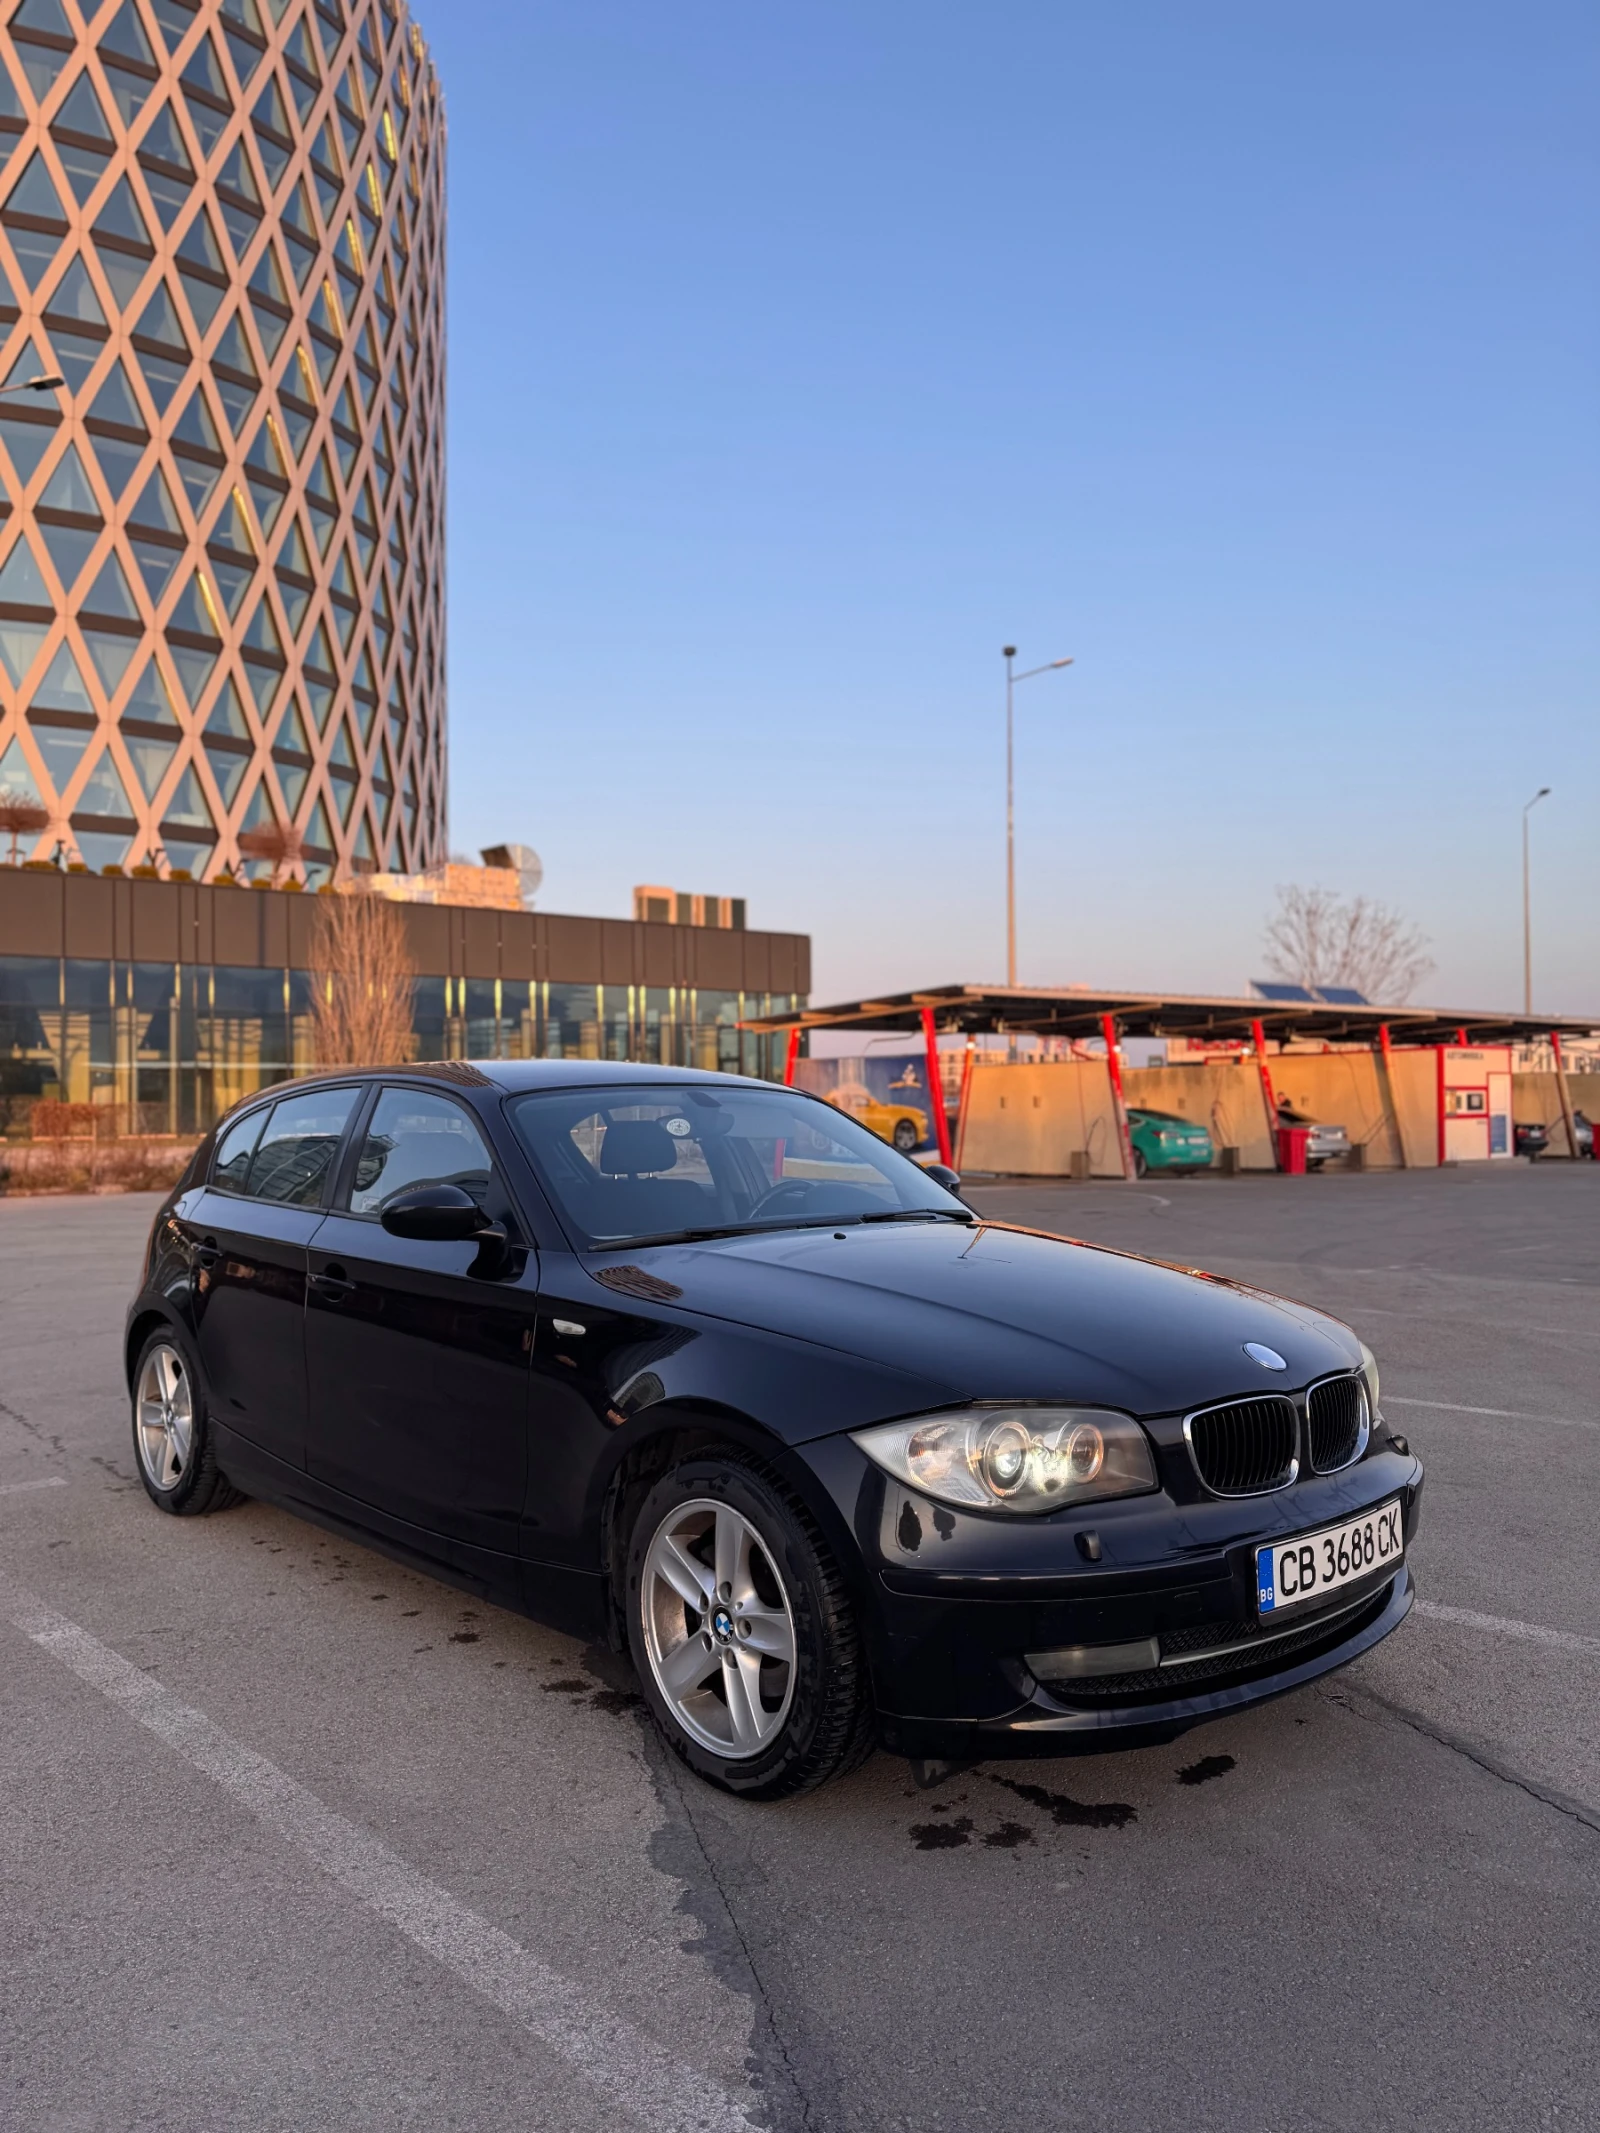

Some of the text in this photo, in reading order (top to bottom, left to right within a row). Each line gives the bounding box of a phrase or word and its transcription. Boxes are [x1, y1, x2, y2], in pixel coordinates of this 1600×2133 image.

[1279, 1507, 1400, 1596] CB 3688 CK
[1259, 1587, 1273, 1603] BG
